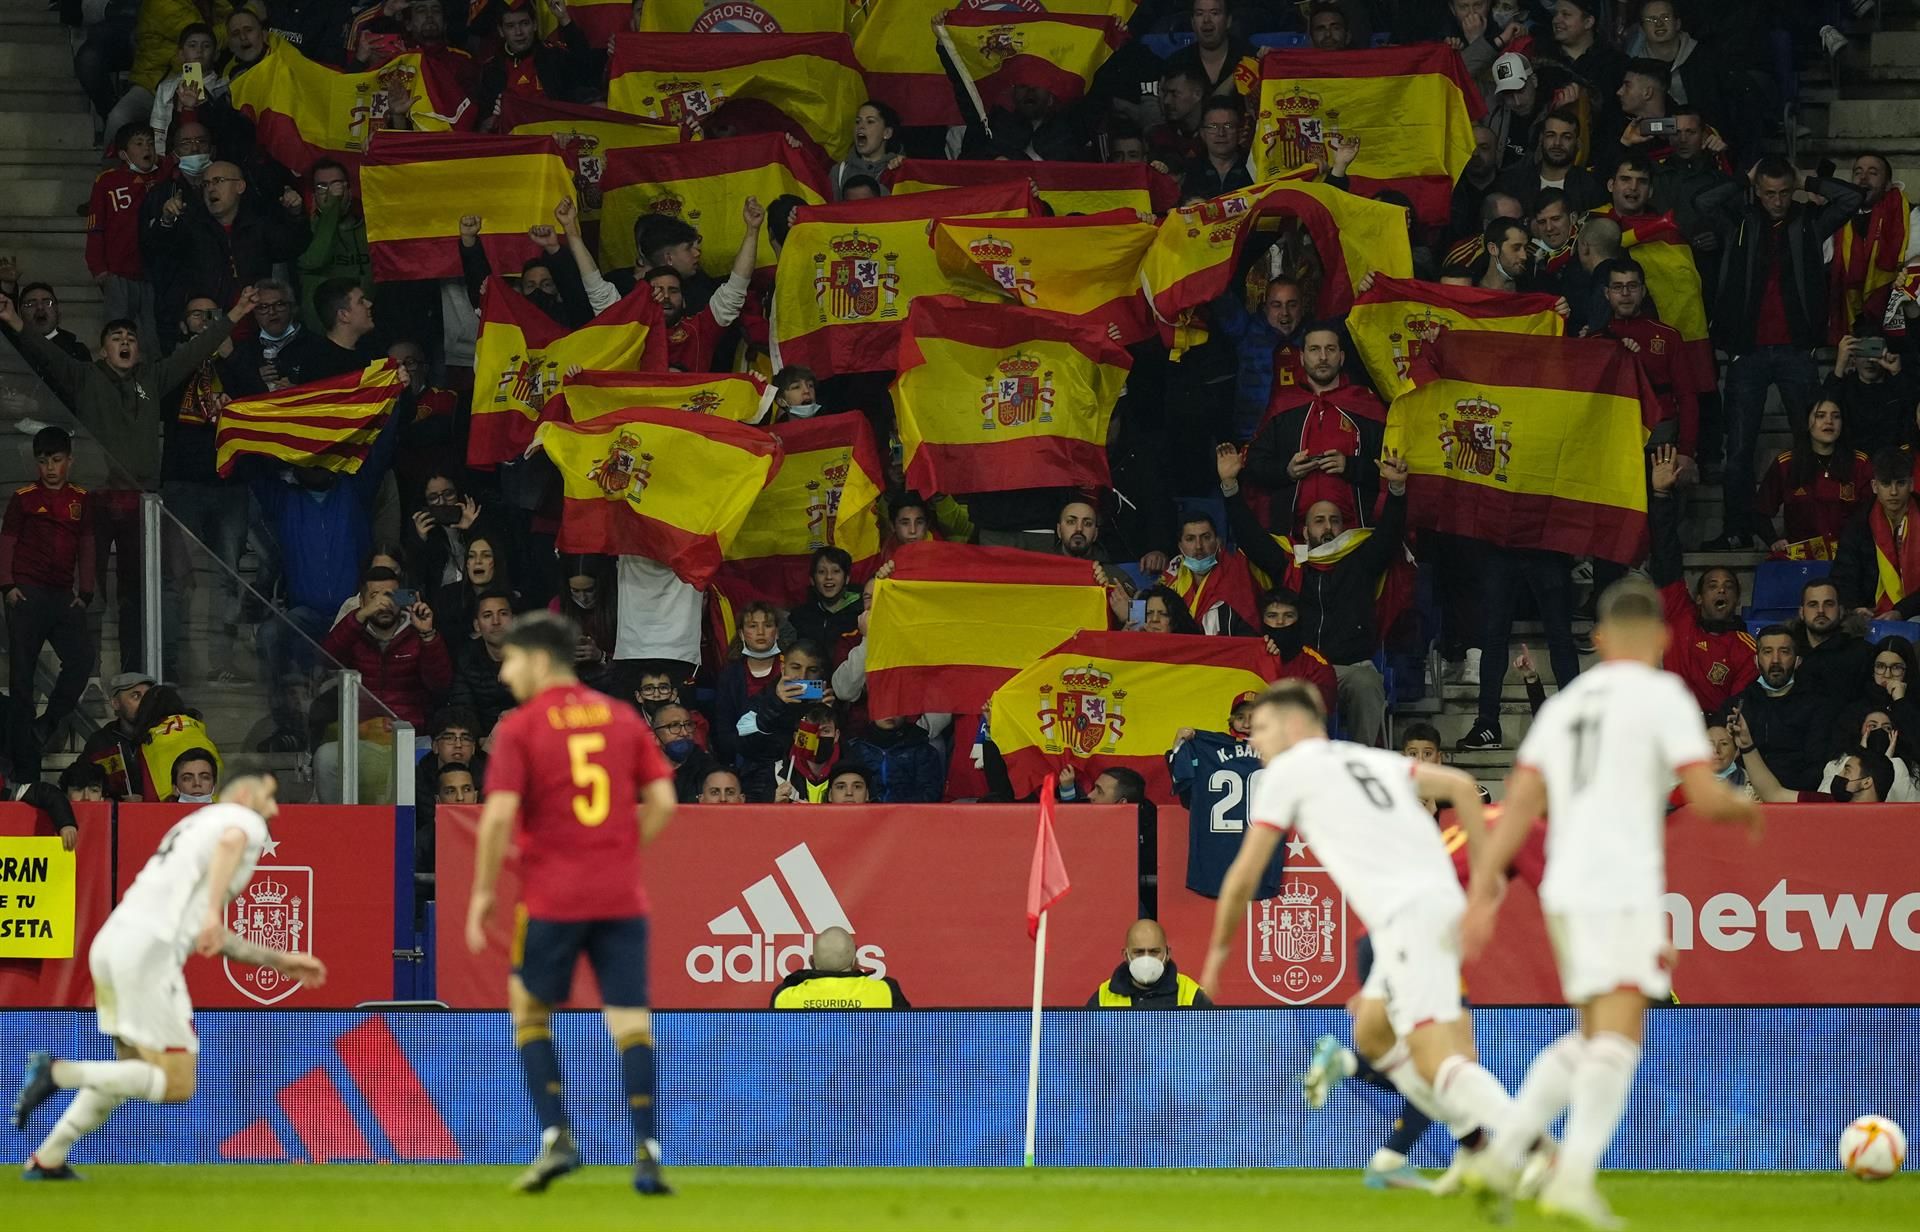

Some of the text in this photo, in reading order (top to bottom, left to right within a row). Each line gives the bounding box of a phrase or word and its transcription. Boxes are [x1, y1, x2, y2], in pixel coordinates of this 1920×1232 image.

[107, 186, 132, 212] 15
[1279, 367, 1295, 386] 6
[1216, 747, 1234, 763] K.
[567, 732, 610, 827] 5
[0, 857, 48, 882] RAN
[16, 895, 35, 908] TU
[0, 919, 53, 938] SETA
[685, 933, 887, 983] adids
[245, 973, 254, 982] 19
[1272, 974, 1282, 983] 19
[1290, 971, 1304, 979] RF
[1311, 974, 1323, 983] 09
[803, 999, 862, 1009] SEGURIDAD
